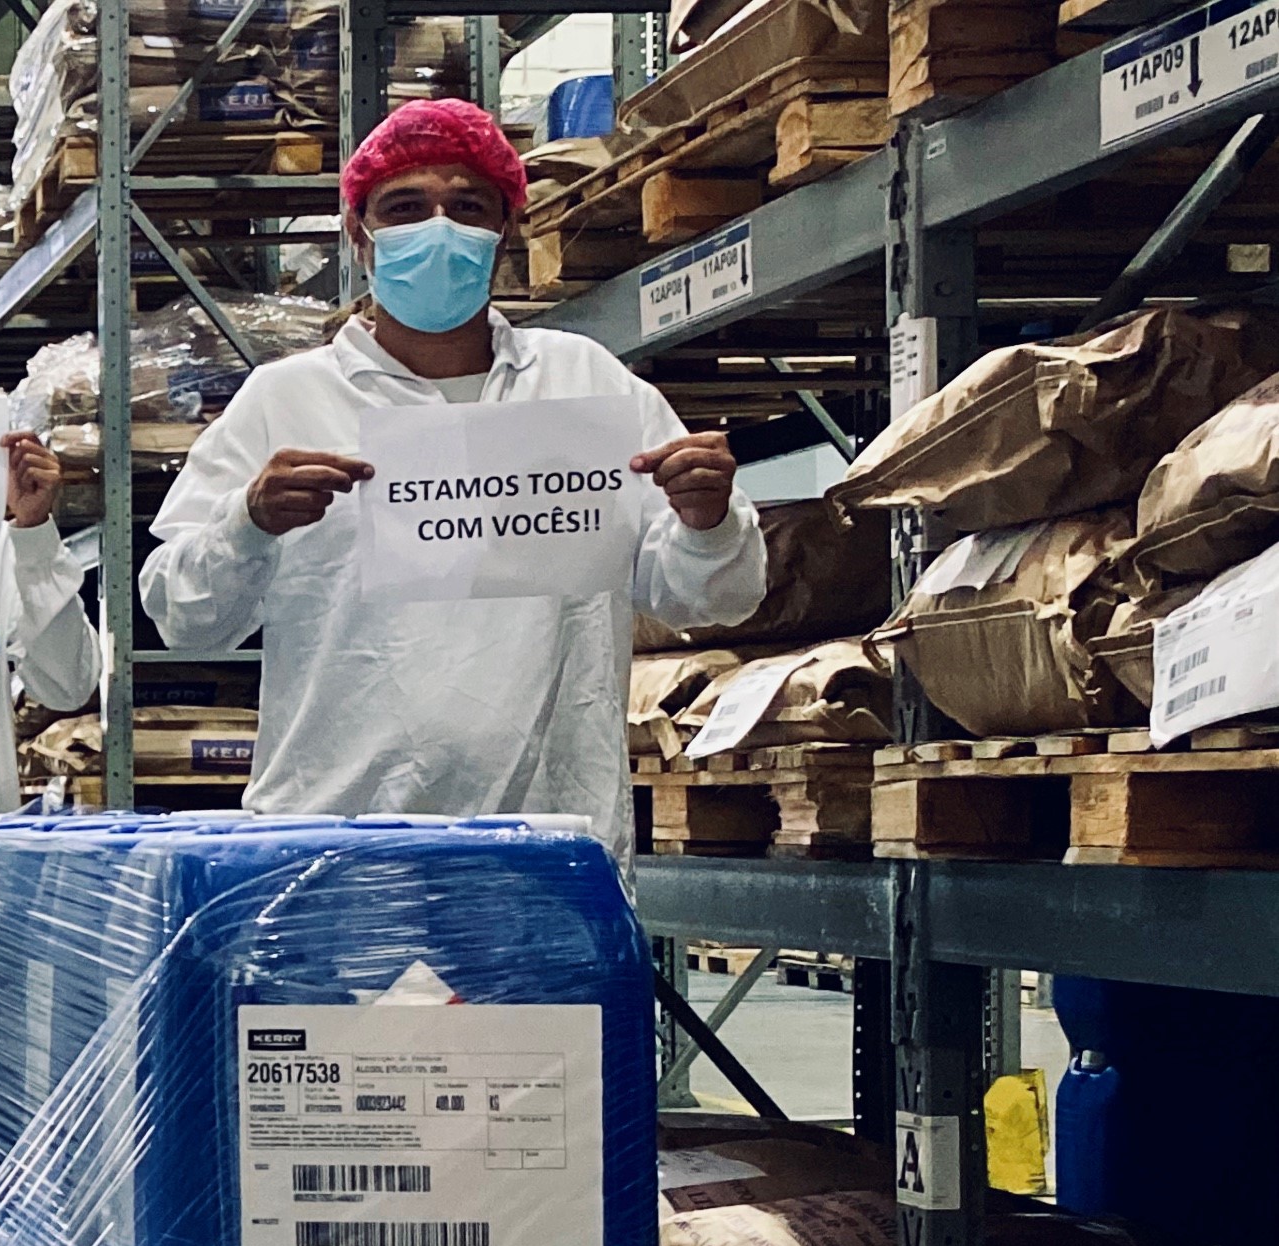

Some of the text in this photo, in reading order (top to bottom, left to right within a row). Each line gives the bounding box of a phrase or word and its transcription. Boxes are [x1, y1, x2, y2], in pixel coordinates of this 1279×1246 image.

[1228, 8, 1279, 49] 12AP
[1120, 44, 1184, 91] 11AP09
[388, 469, 623, 503] ESTAMOS TODOS
[418, 506, 601, 541] COM VOCÊS!!
[203, 746, 252, 759] KER
[253, 1033, 303, 1044] KERRY
[246, 1062, 341, 1085] 20617538
[898, 1131, 925, 1194] A
